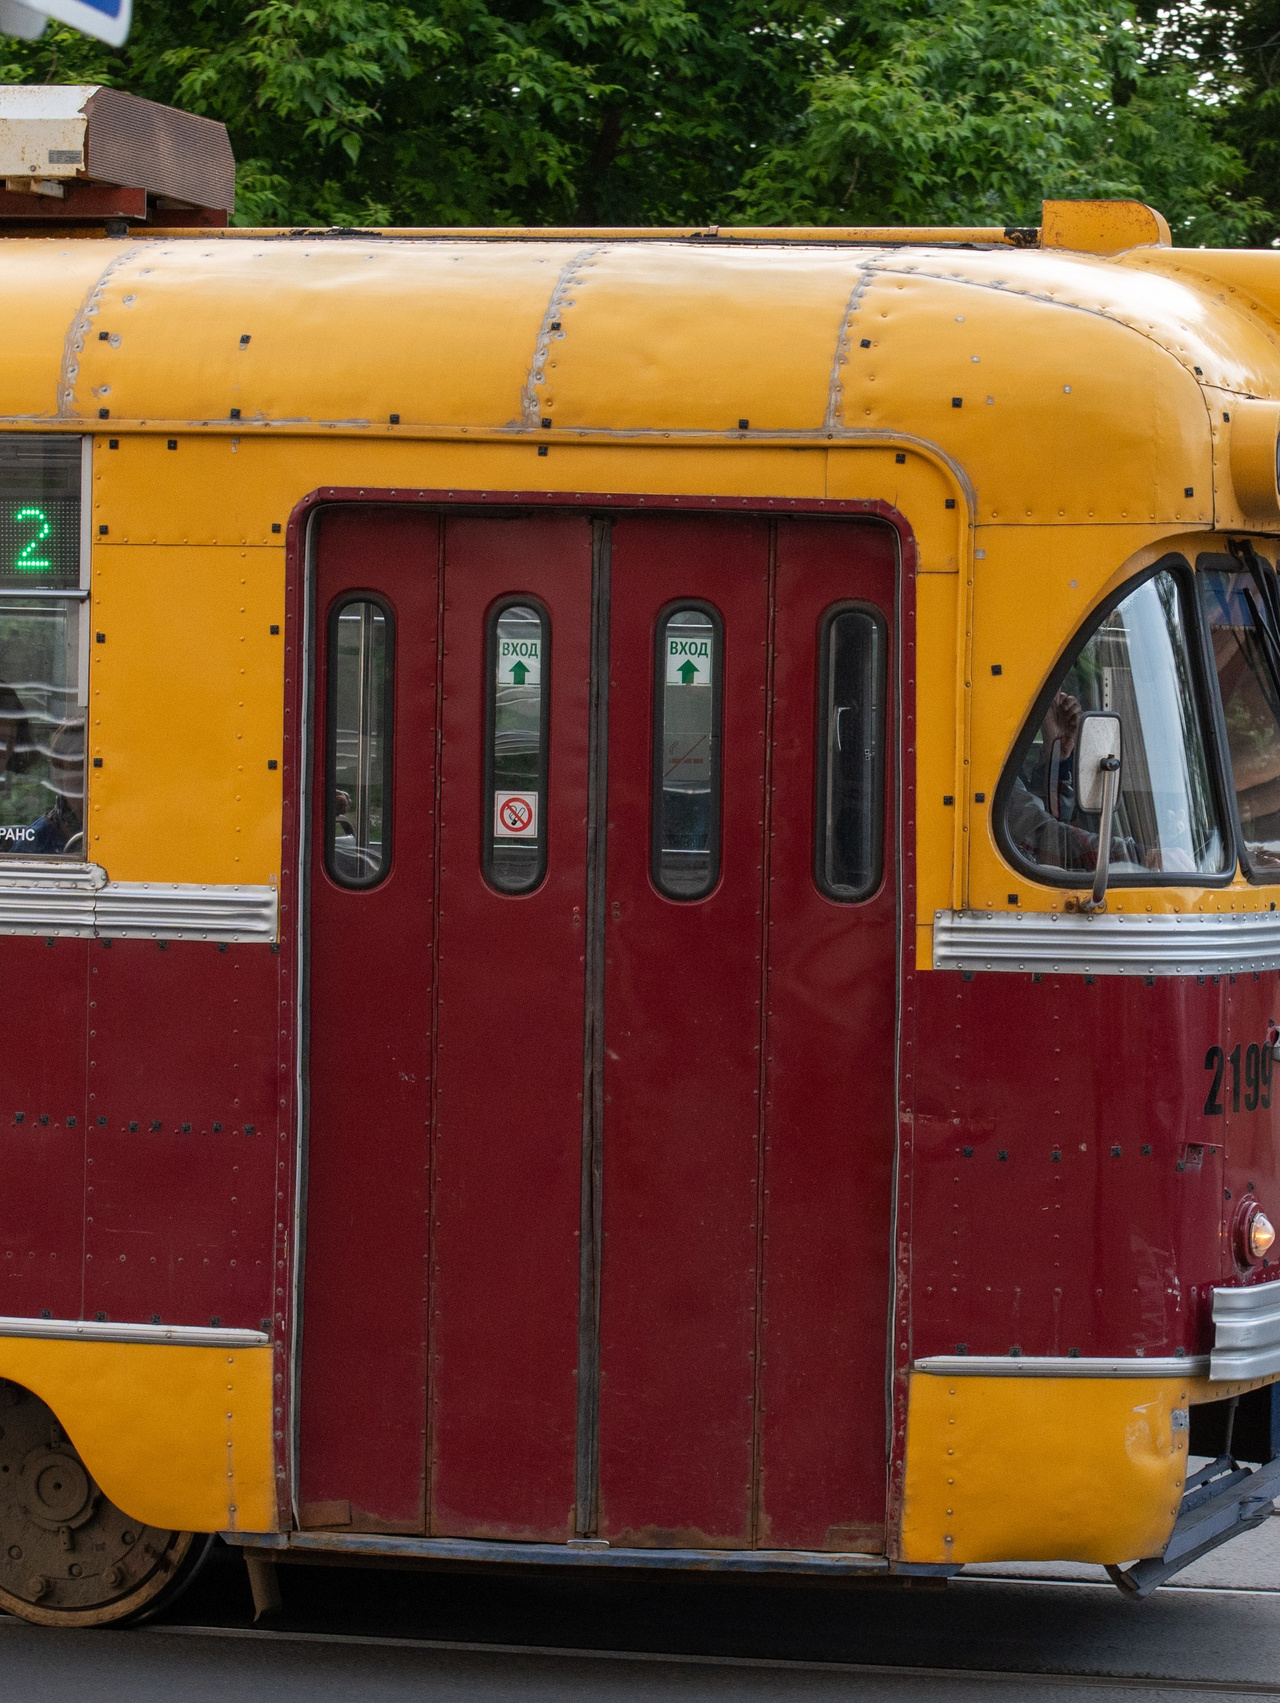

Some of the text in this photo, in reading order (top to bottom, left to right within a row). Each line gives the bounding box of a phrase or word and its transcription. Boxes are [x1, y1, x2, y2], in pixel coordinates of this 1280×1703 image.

[17, 508, 50, 568] 2
[502, 642, 539, 659] ВХОД
[670, 641, 709, 658] ВХОД
[1204, 1041, 1273, 1115] 2199
